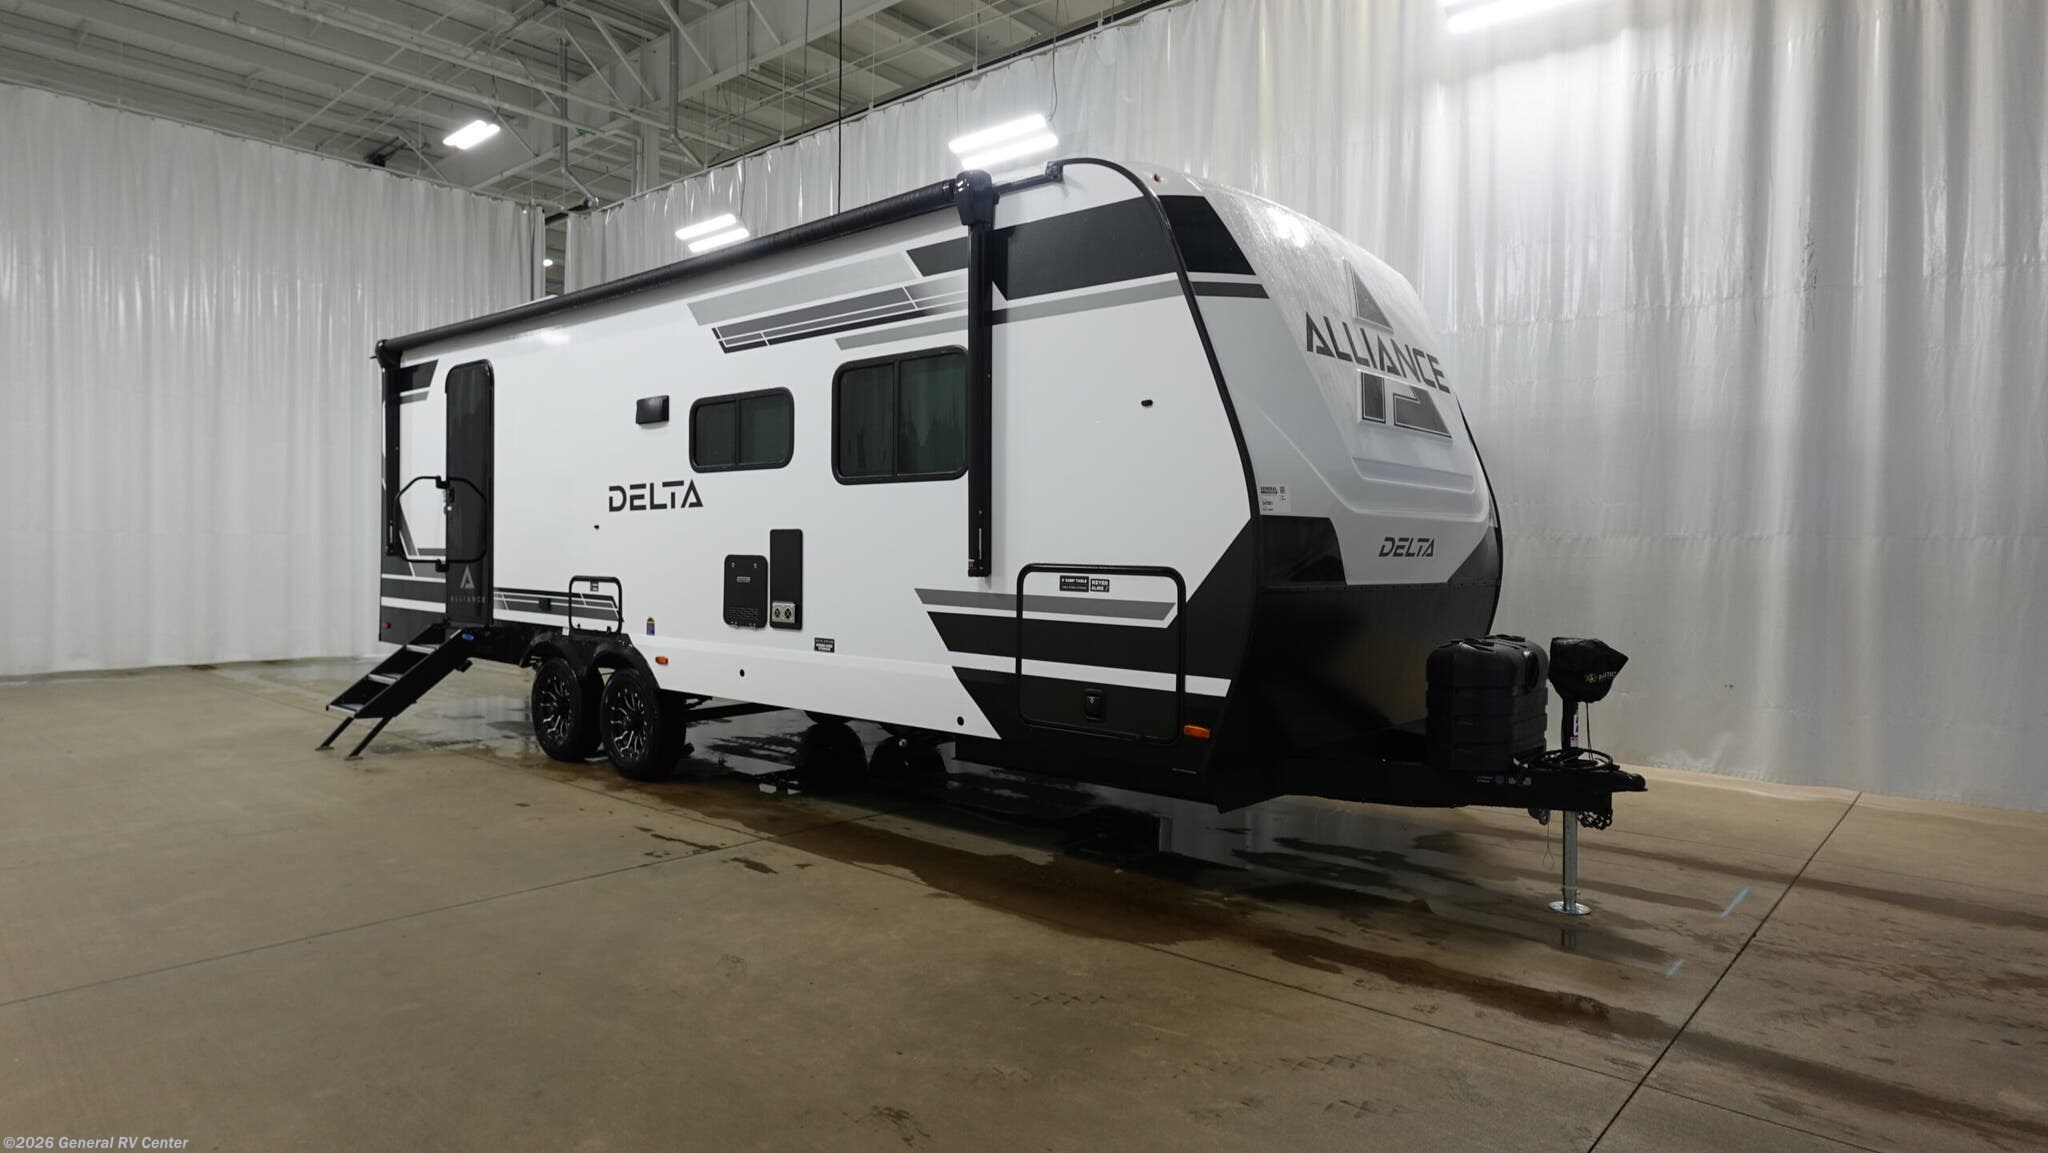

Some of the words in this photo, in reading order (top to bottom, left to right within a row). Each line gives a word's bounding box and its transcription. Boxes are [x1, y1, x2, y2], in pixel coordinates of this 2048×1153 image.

[1306, 312, 1450, 394] ALLIANCE
[608, 479, 704, 512] DELTA
[1379, 536, 1434, 557] DELTA
